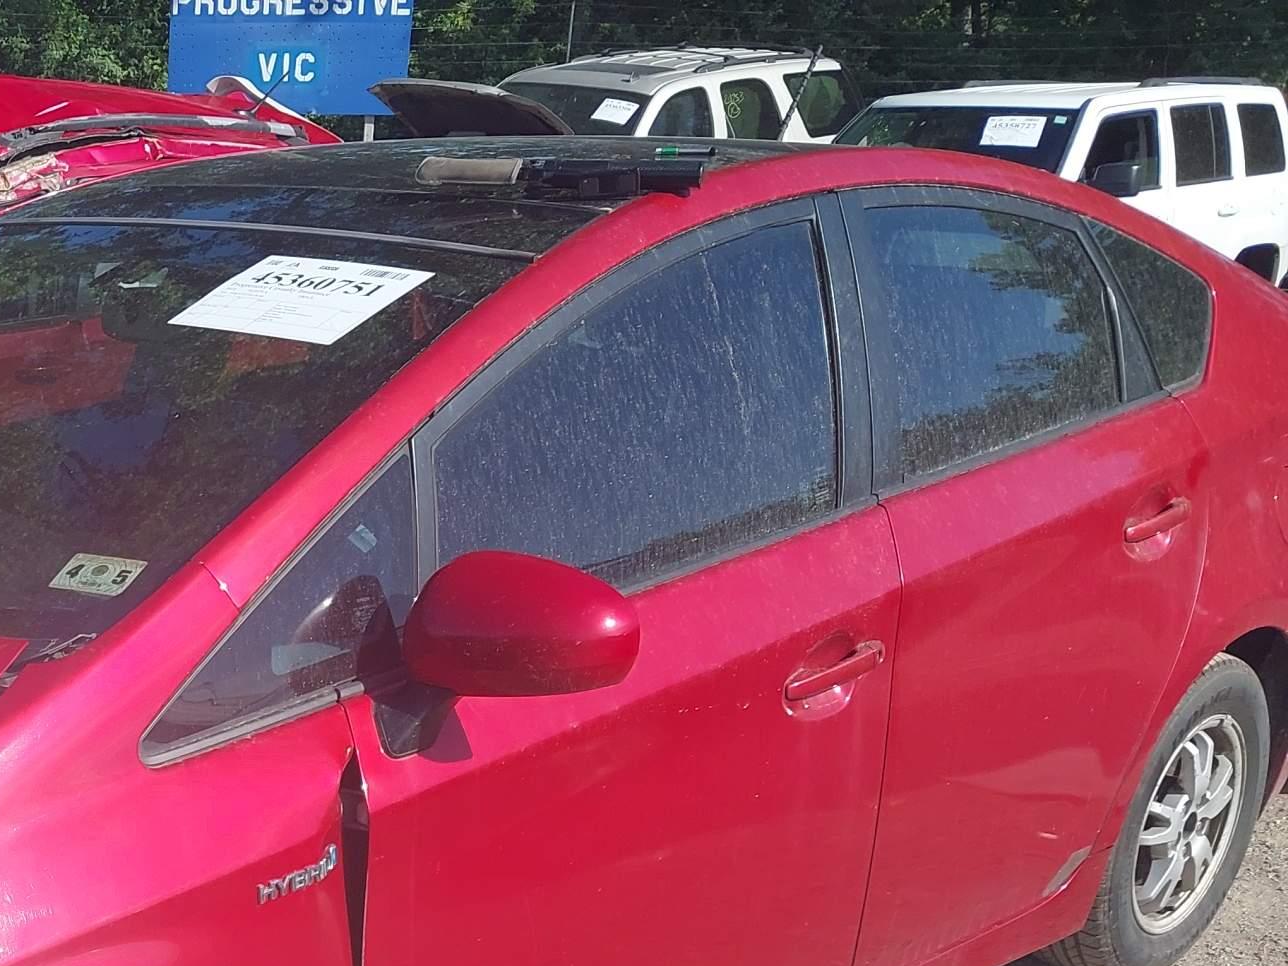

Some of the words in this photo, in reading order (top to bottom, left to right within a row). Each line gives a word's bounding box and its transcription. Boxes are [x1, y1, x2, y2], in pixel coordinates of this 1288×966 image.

[172, 0, 411, 16] PROGRESSIVE
[258, 52, 316, 82] VIC
[251, 271, 385, 297] 45360751
[65, 564, 86, 579] 4
[112, 569, 133, 585] 5
